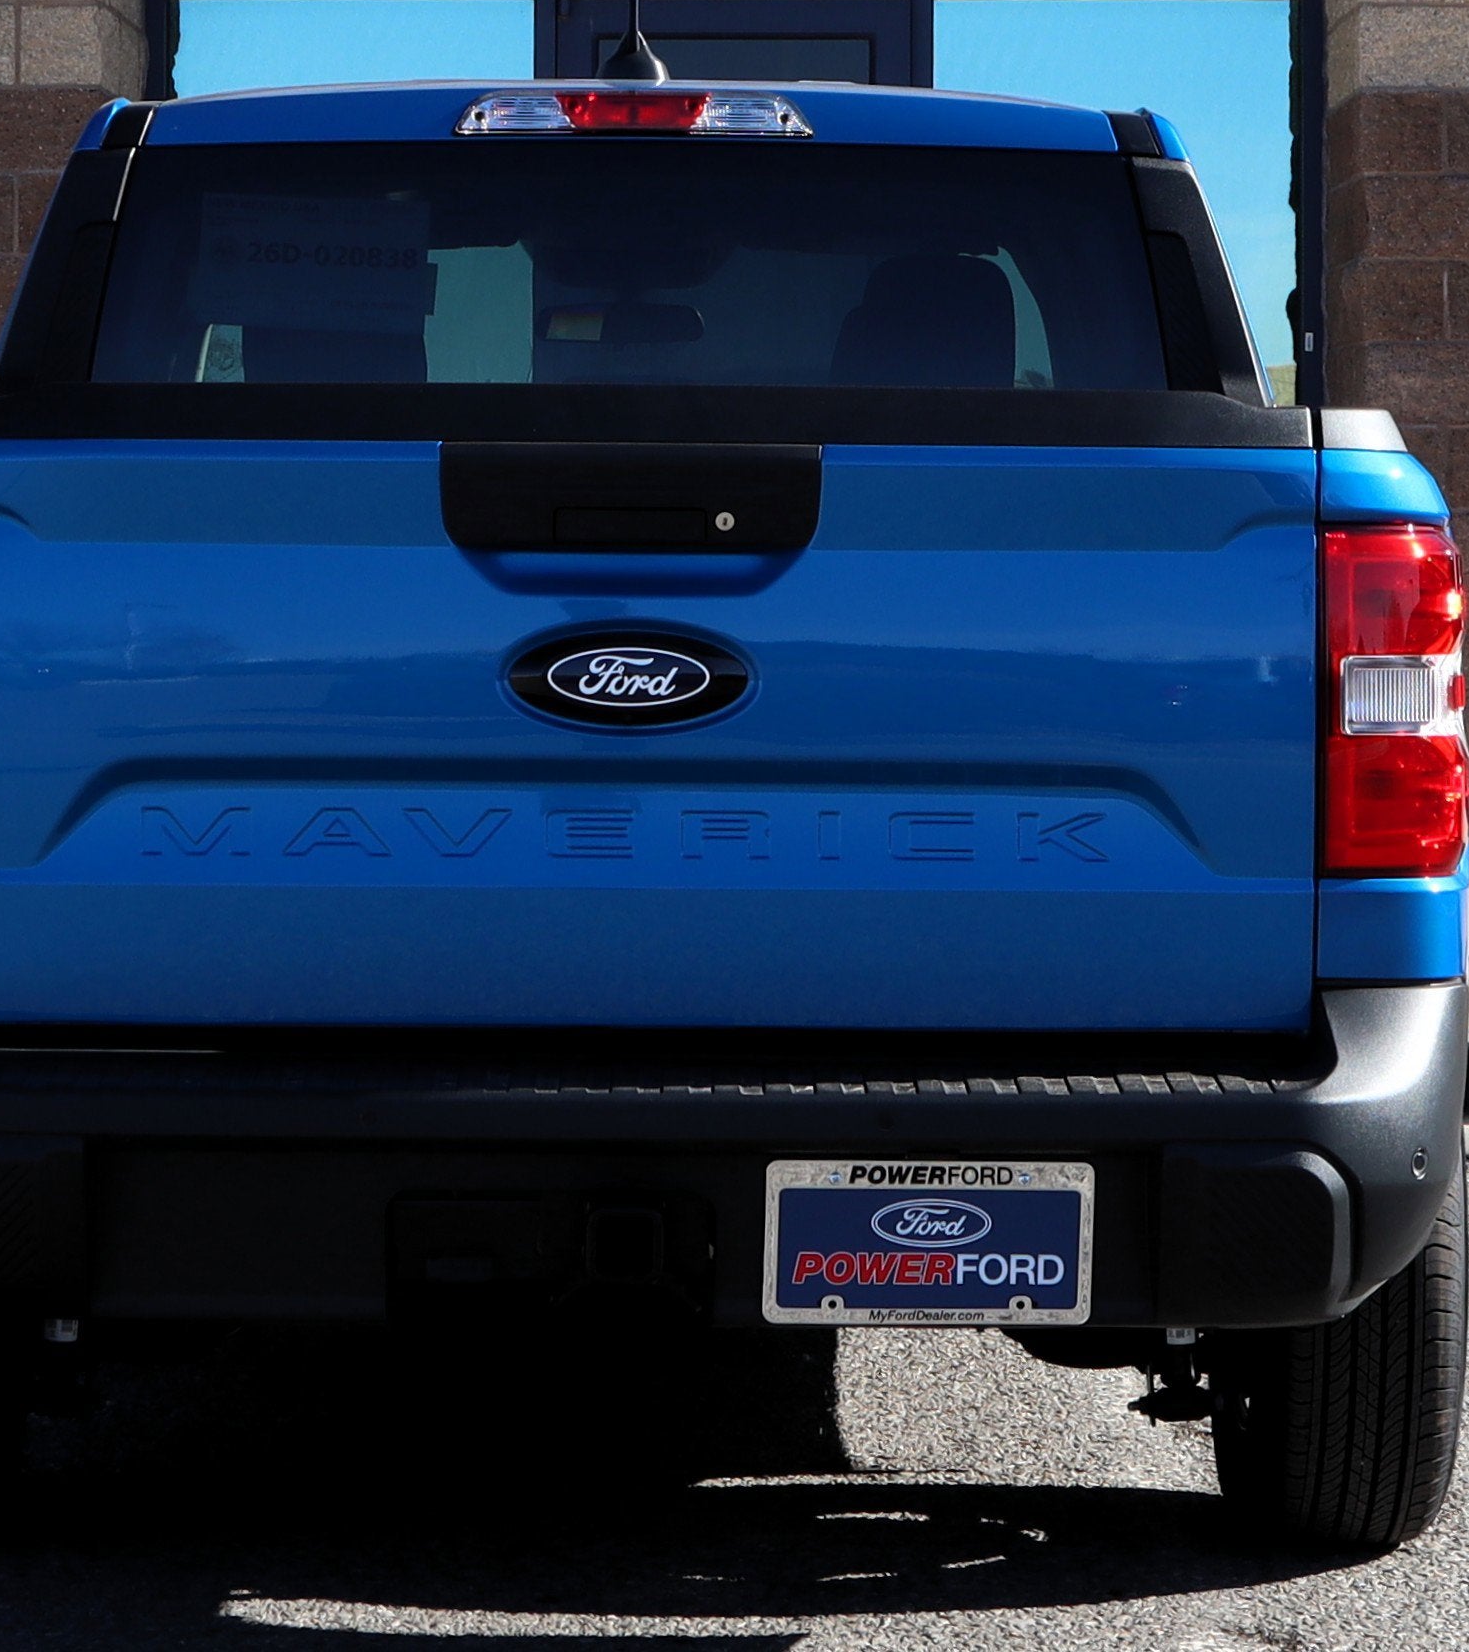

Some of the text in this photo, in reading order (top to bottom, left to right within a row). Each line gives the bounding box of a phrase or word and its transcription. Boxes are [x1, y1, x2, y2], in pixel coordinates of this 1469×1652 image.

[578, 655, 679, 697] Ford
[140, 805, 1110, 863] MAVERICK
[895, 1206, 967, 1237] Ford
[868, 1309, 985, 1323] MyFordDealer.com
